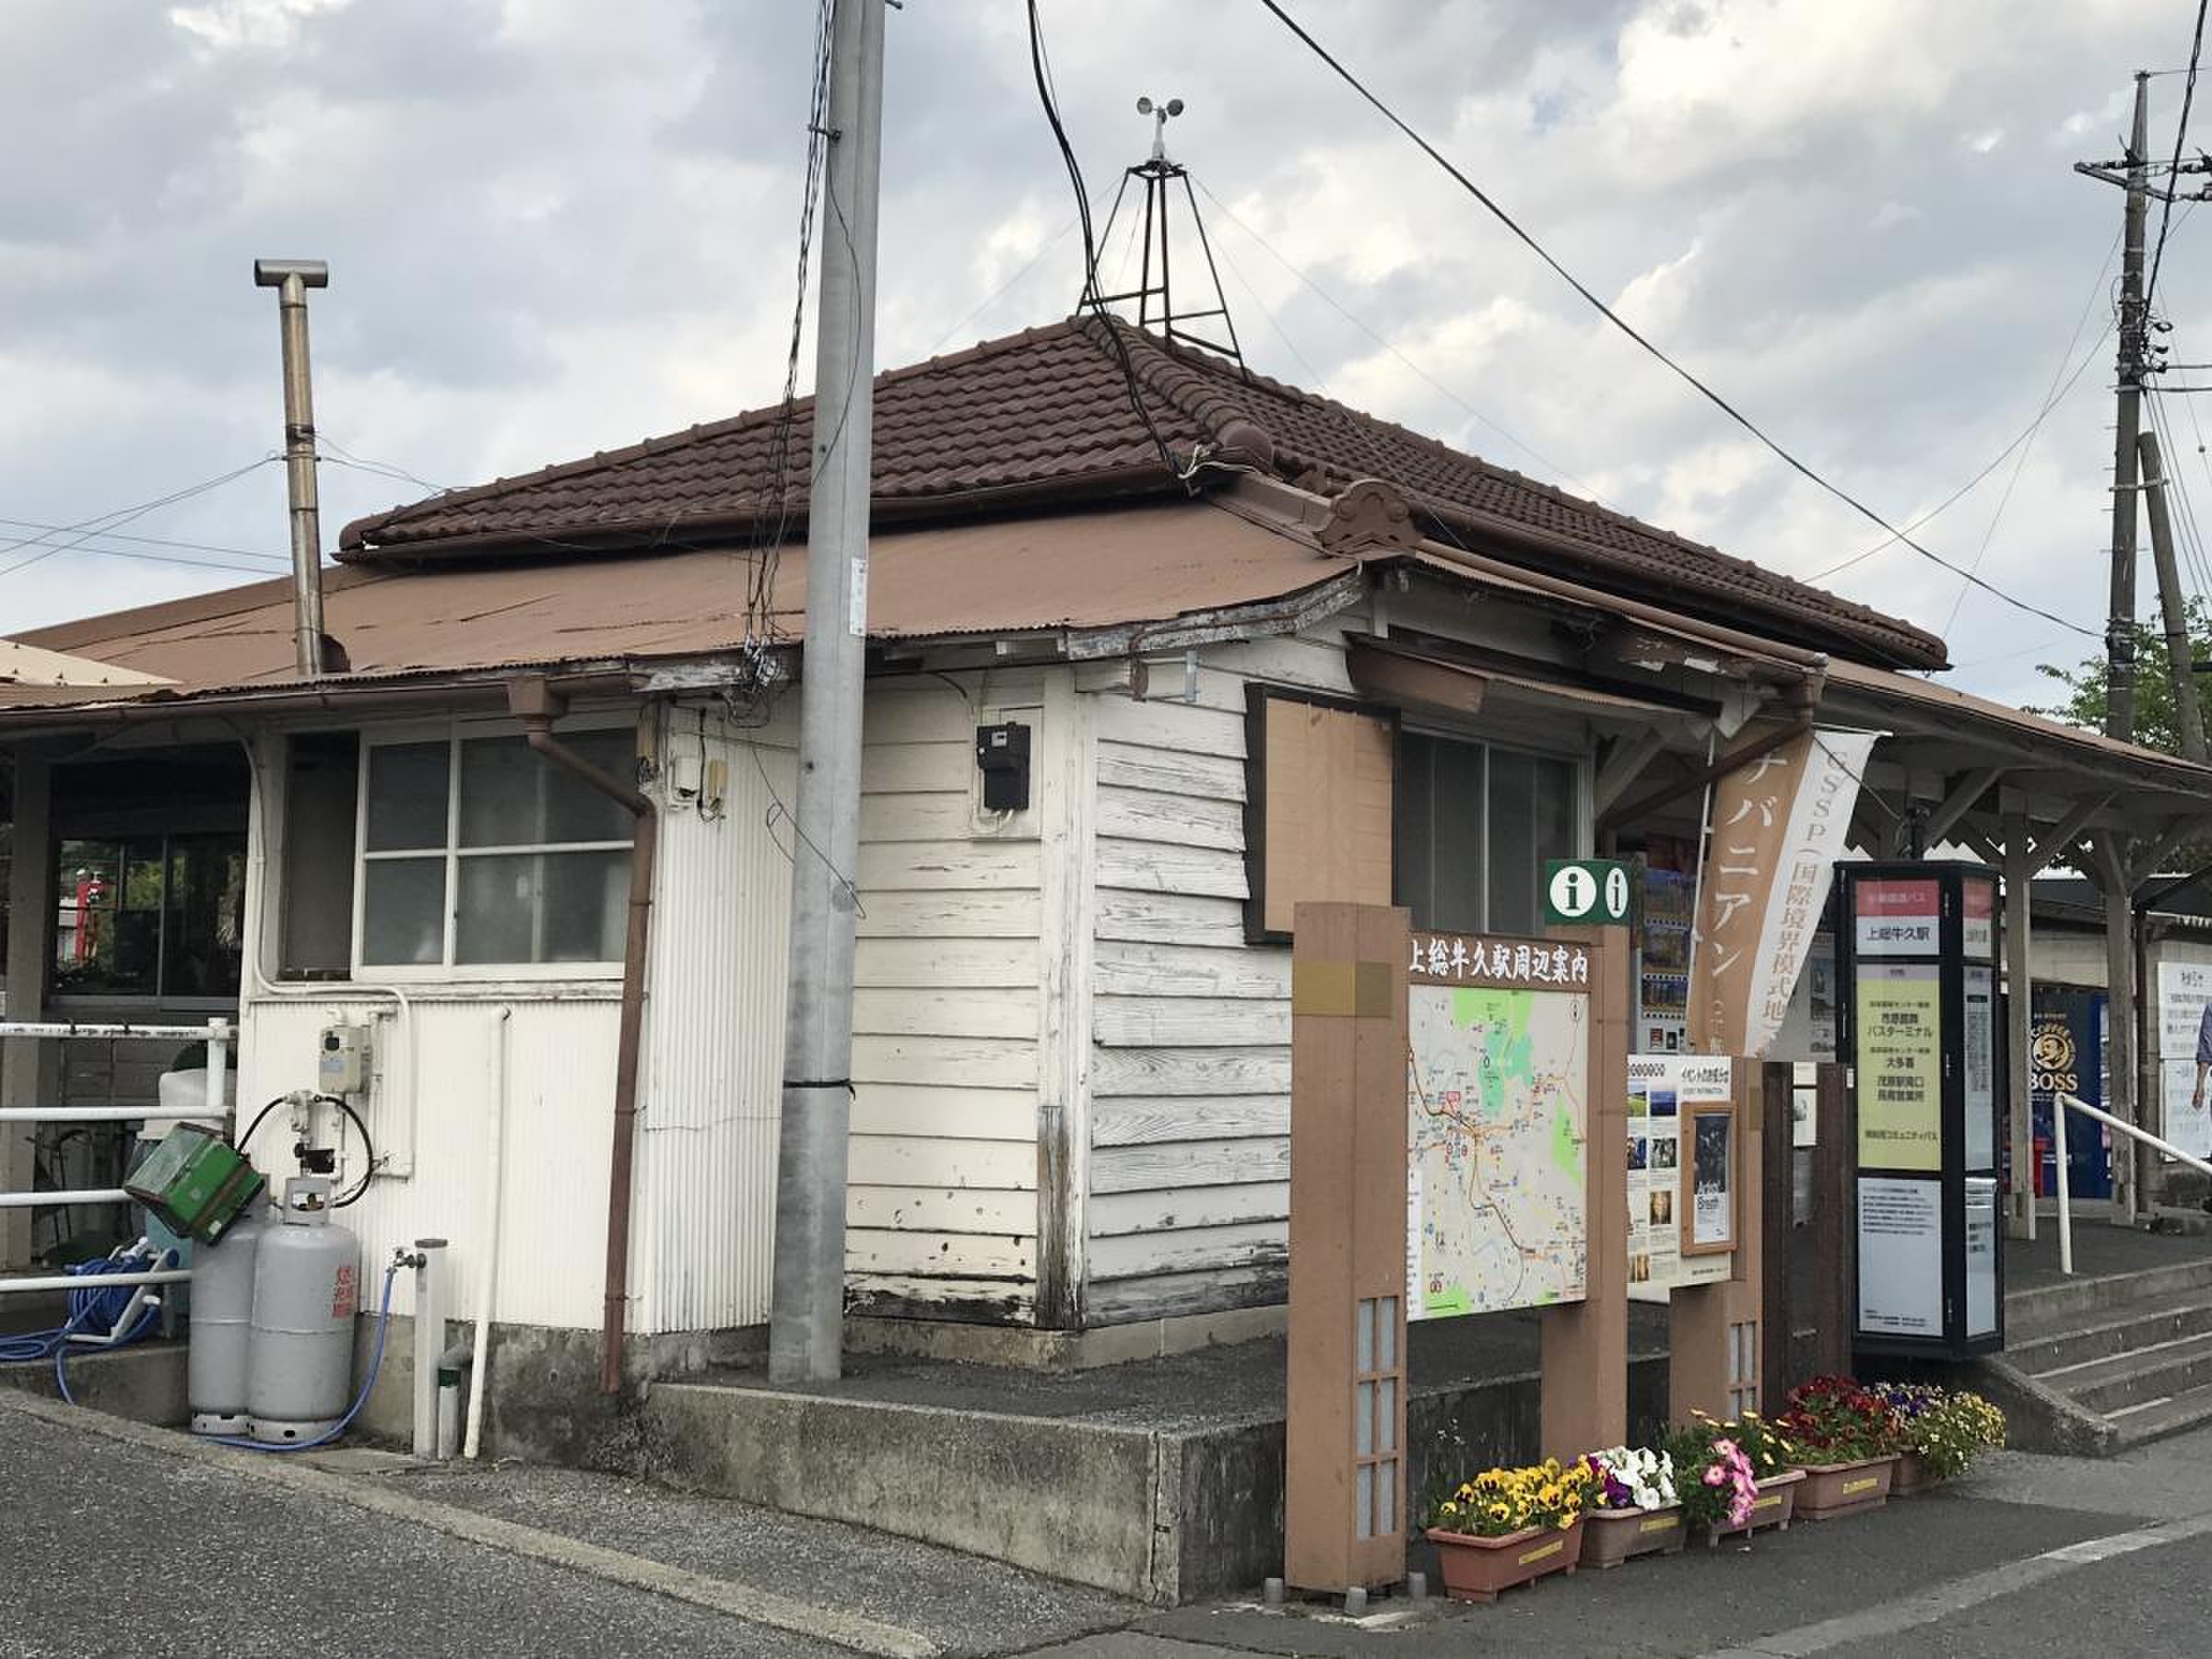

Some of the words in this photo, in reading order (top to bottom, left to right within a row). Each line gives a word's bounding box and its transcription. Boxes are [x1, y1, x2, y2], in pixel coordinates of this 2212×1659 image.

[1409, 936, 1589, 984] 上総牛久駅周辺案内
[2030, 1072, 2078, 1091] BOSS
